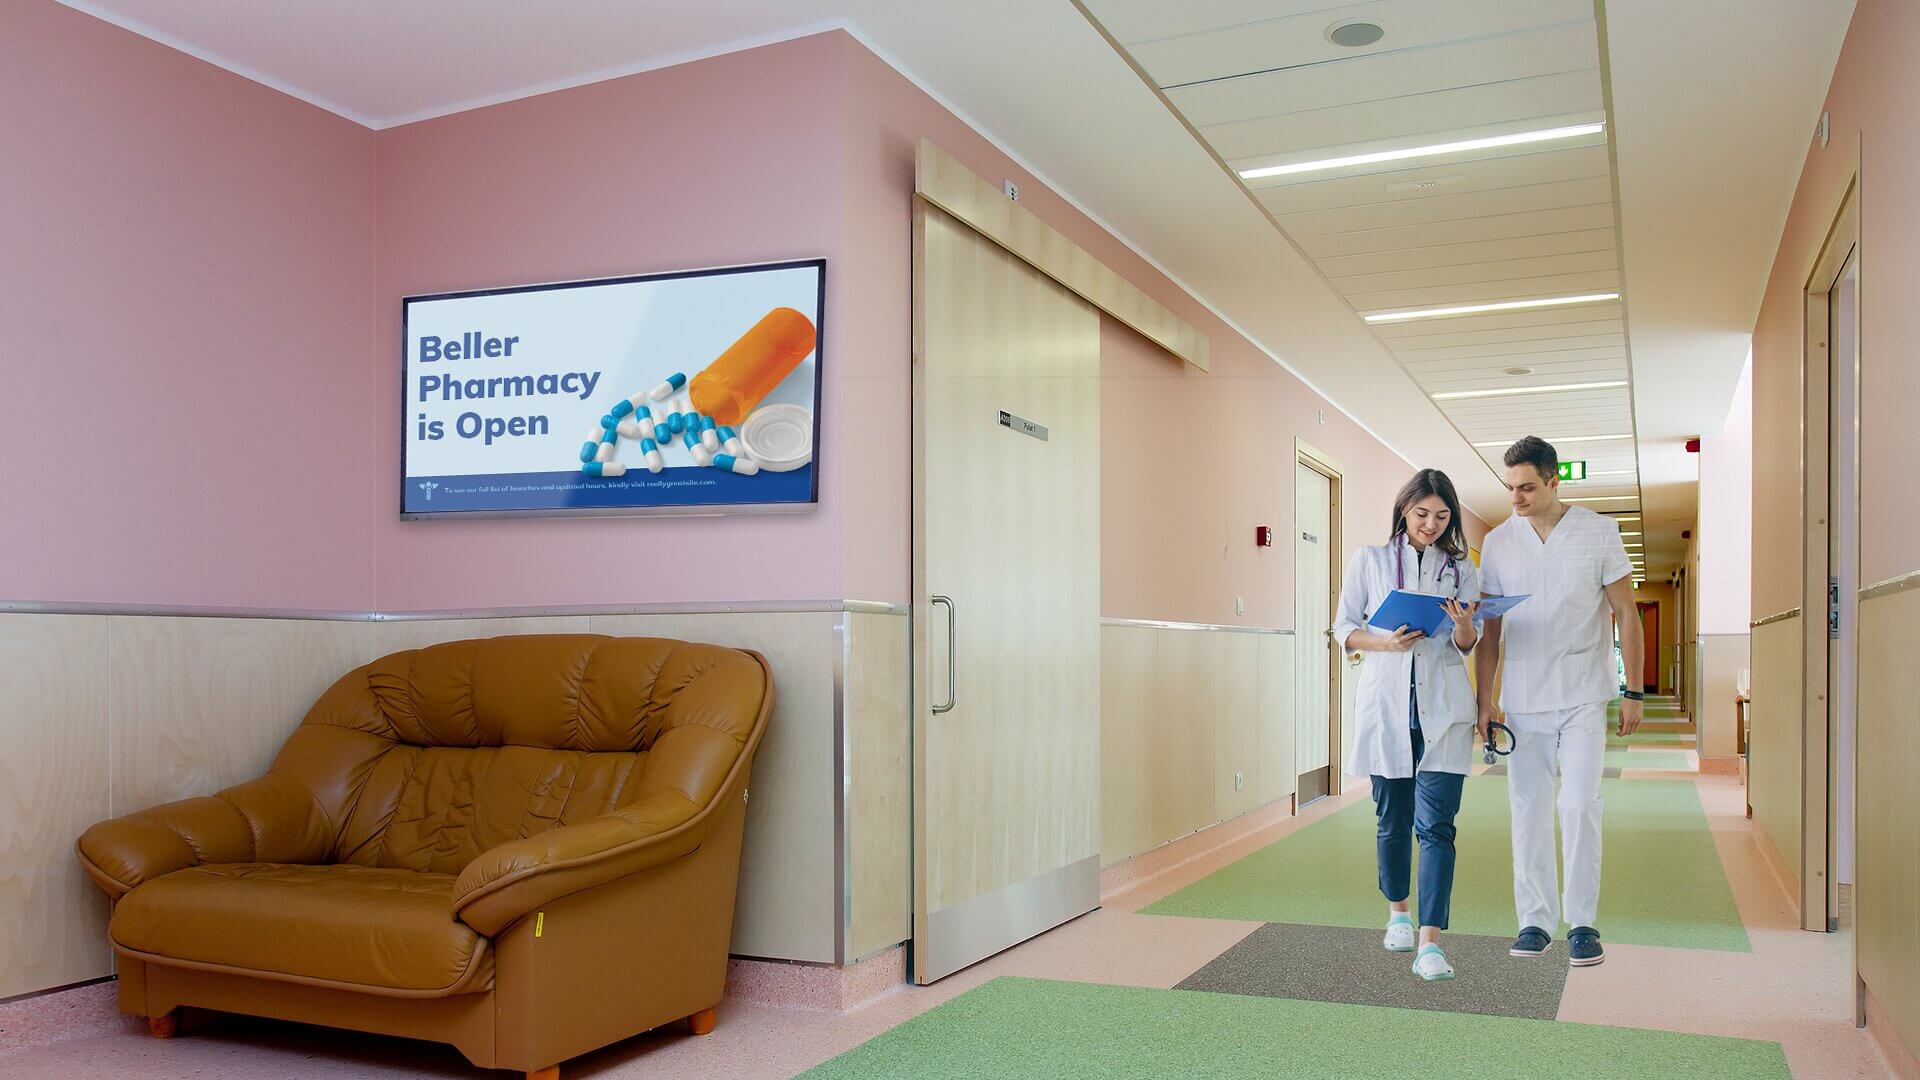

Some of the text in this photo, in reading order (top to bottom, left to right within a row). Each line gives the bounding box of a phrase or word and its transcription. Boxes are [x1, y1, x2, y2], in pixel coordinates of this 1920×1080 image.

[419, 331, 519, 363] Beller
[419, 371, 601, 402] Pharmacy
[418, 412, 549, 446] is Open
[555, 483, 585, 491] updated
[608, 481, 629, 490] kindly
